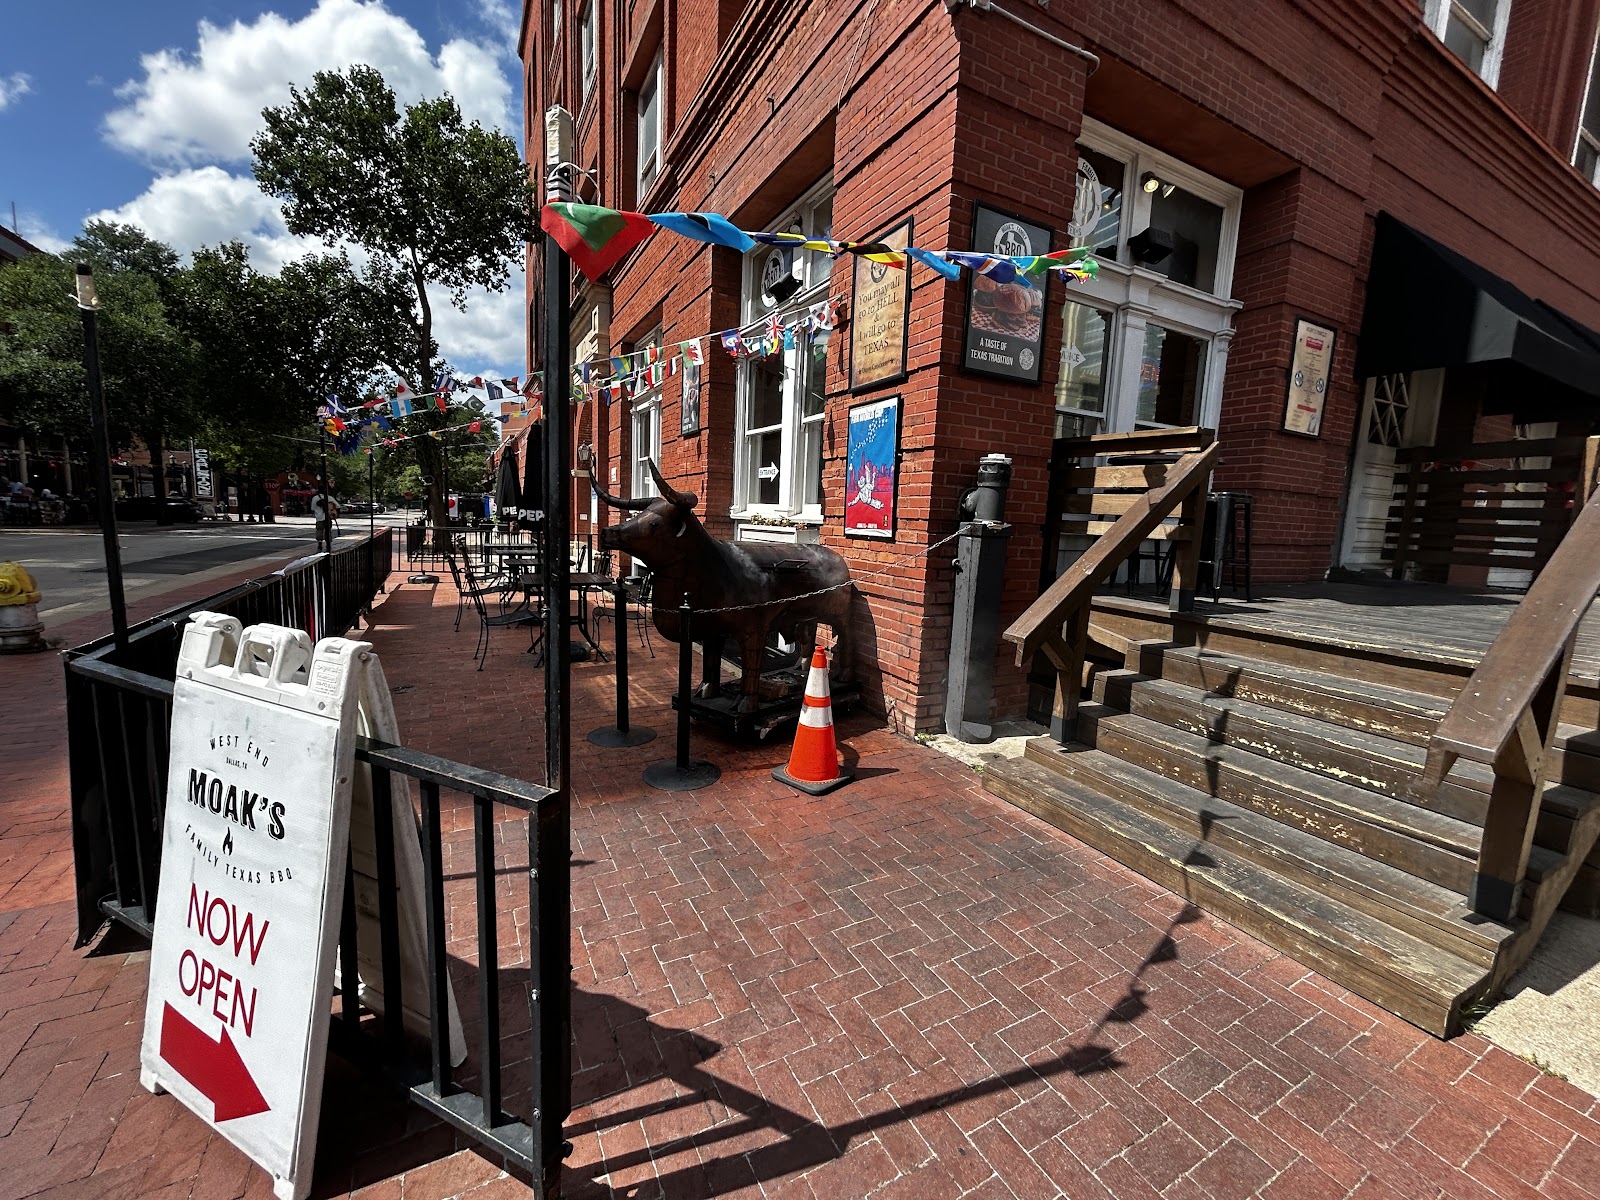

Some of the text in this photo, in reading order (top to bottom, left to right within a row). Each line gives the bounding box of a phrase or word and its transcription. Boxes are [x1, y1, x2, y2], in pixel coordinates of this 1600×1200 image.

[859, 275, 900, 306] You may all
[858, 292, 899, 322] go to HELL
[863, 325, 876, 339] will
[877, 324, 886, 337] go
[887, 320, 896, 330] to
[979, 337, 1007, 351] A TASTE OF
[864, 337, 889, 355] TEXAS
[970, 349, 987, 361] TEXAS
[988, 352, 1014, 366] TRADITION
[501, 506, 518, 516] PE
[518, 508, 546, 522] PEP
[209, 734, 269, 768] WEST END
[187, 767, 286, 841] MOAK'S
[185, 823, 293, 885] FAMILY TEXAS BBQ
[187, 882, 270, 967] NOW
[178, 949, 258, 1039] OPEN
